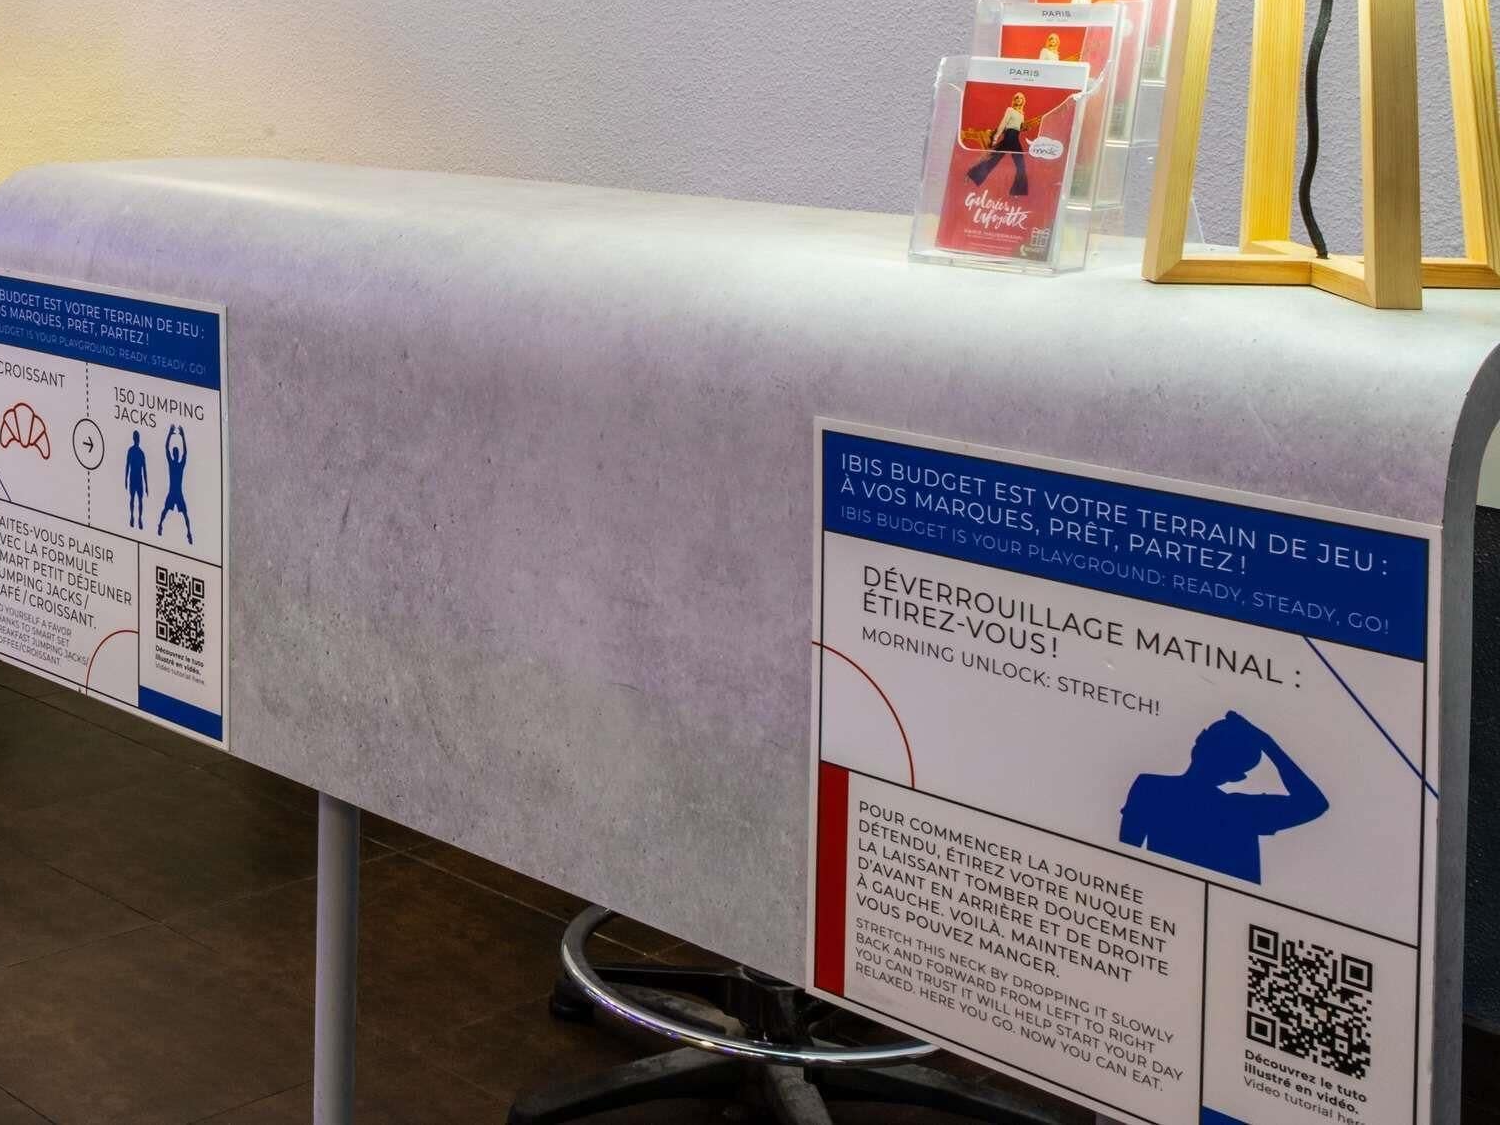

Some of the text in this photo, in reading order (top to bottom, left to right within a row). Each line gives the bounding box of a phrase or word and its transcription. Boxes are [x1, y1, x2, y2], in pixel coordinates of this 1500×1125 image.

[1009, 68, 1040, 77] PARIS
[9, 306, 65, 330] MARQUES,
[67, 317, 98, 337] PRÊT,
[35, 331, 58, 344] YOUR
[59, 335, 117, 357] PLAYGROUND:
[118, 347, 148, 364] READY,
[152, 354, 188, 372] STEADY,
[189, 362, 206, 375] GO!
[43, 296, 62, 311] EST
[64, 301, 101, 320] VOTRE
[103, 307, 153, 329] TERRAIN
[156, 317, 173, 333] DE
[113, 386, 204, 421] 150 JUMPING
[114, 404, 157, 429] JACKS
[840, 473, 855, 495] À
[861, 480, 907, 506] VOS
[915, 491, 1040, 536] MARQUES,
[1050, 517, 1119, 552] PRÊT,
[842, 453, 883, 477] IBIS
[891, 462, 986, 496] BUDGET
[994, 481, 1037, 506] EST
[1044, 490, 1128, 525] VOTRE
[1136, 508, 1256, 550] TERRAIN
[1268, 533, 1307, 560] DE
[24, 540, 39, 557] LA
[41, 545, 99, 577] FORMULE
[33, 560, 65, 582] PETIT
[67, 571, 132, 606] DÉJEUNER
[68, 536, 114, 564] PLAISIR
[841, 505, 1389, 635] IBIS BUDGET IS YOUR PLAYGROUND: READY, STEADY, GO!
[863, 565, 1123, 646] DÉVERROUILLAGE
[862, 626, 1160, 717] MORNING UNLOCK: STRETCH!
[859, 800, 1144, 905] POUR COMMENCER LA JOURNÉE
[859, 818, 1176, 937] DÉTENDU, ÉTIREZ VOTRE NUQUE EN
[856, 872, 1132, 983] À GAUCHE. VOILÀ. MAINTENANT
[856, 892, 1060, 978] VOUS POUVEZ MANGER.
[858, 837, 1167, 953] LA LAISSANT TOMBER DOUCEMENT
[858, 856, 1169, 977] D'AVANT EN ARRIÈRE ET DE DROITE
[855, 946, 1184, 1081] YOU CAN TRUST IT WILL HELP START YOUR DAY
[856, 917, 1174, 1044] STRETCH THIS NECK BY DROPPING IT SLOWLY
[856, 931, 1155, 1054] BACK AND FORWARD FROM LEFT TO RIGHT
[855, 961, 1163, 1092] RELAXED. HERE YOU GO. NOW YOU CAN EAT.
[1243, 1076, 1281, 1098] Video
[1284, 1092, 1333, 1118] tutorial
[1244, 1061, 1359, 1115] illustré en vidéo.
[1245, 1049, 1367, 1103] Découvrez le tuto
